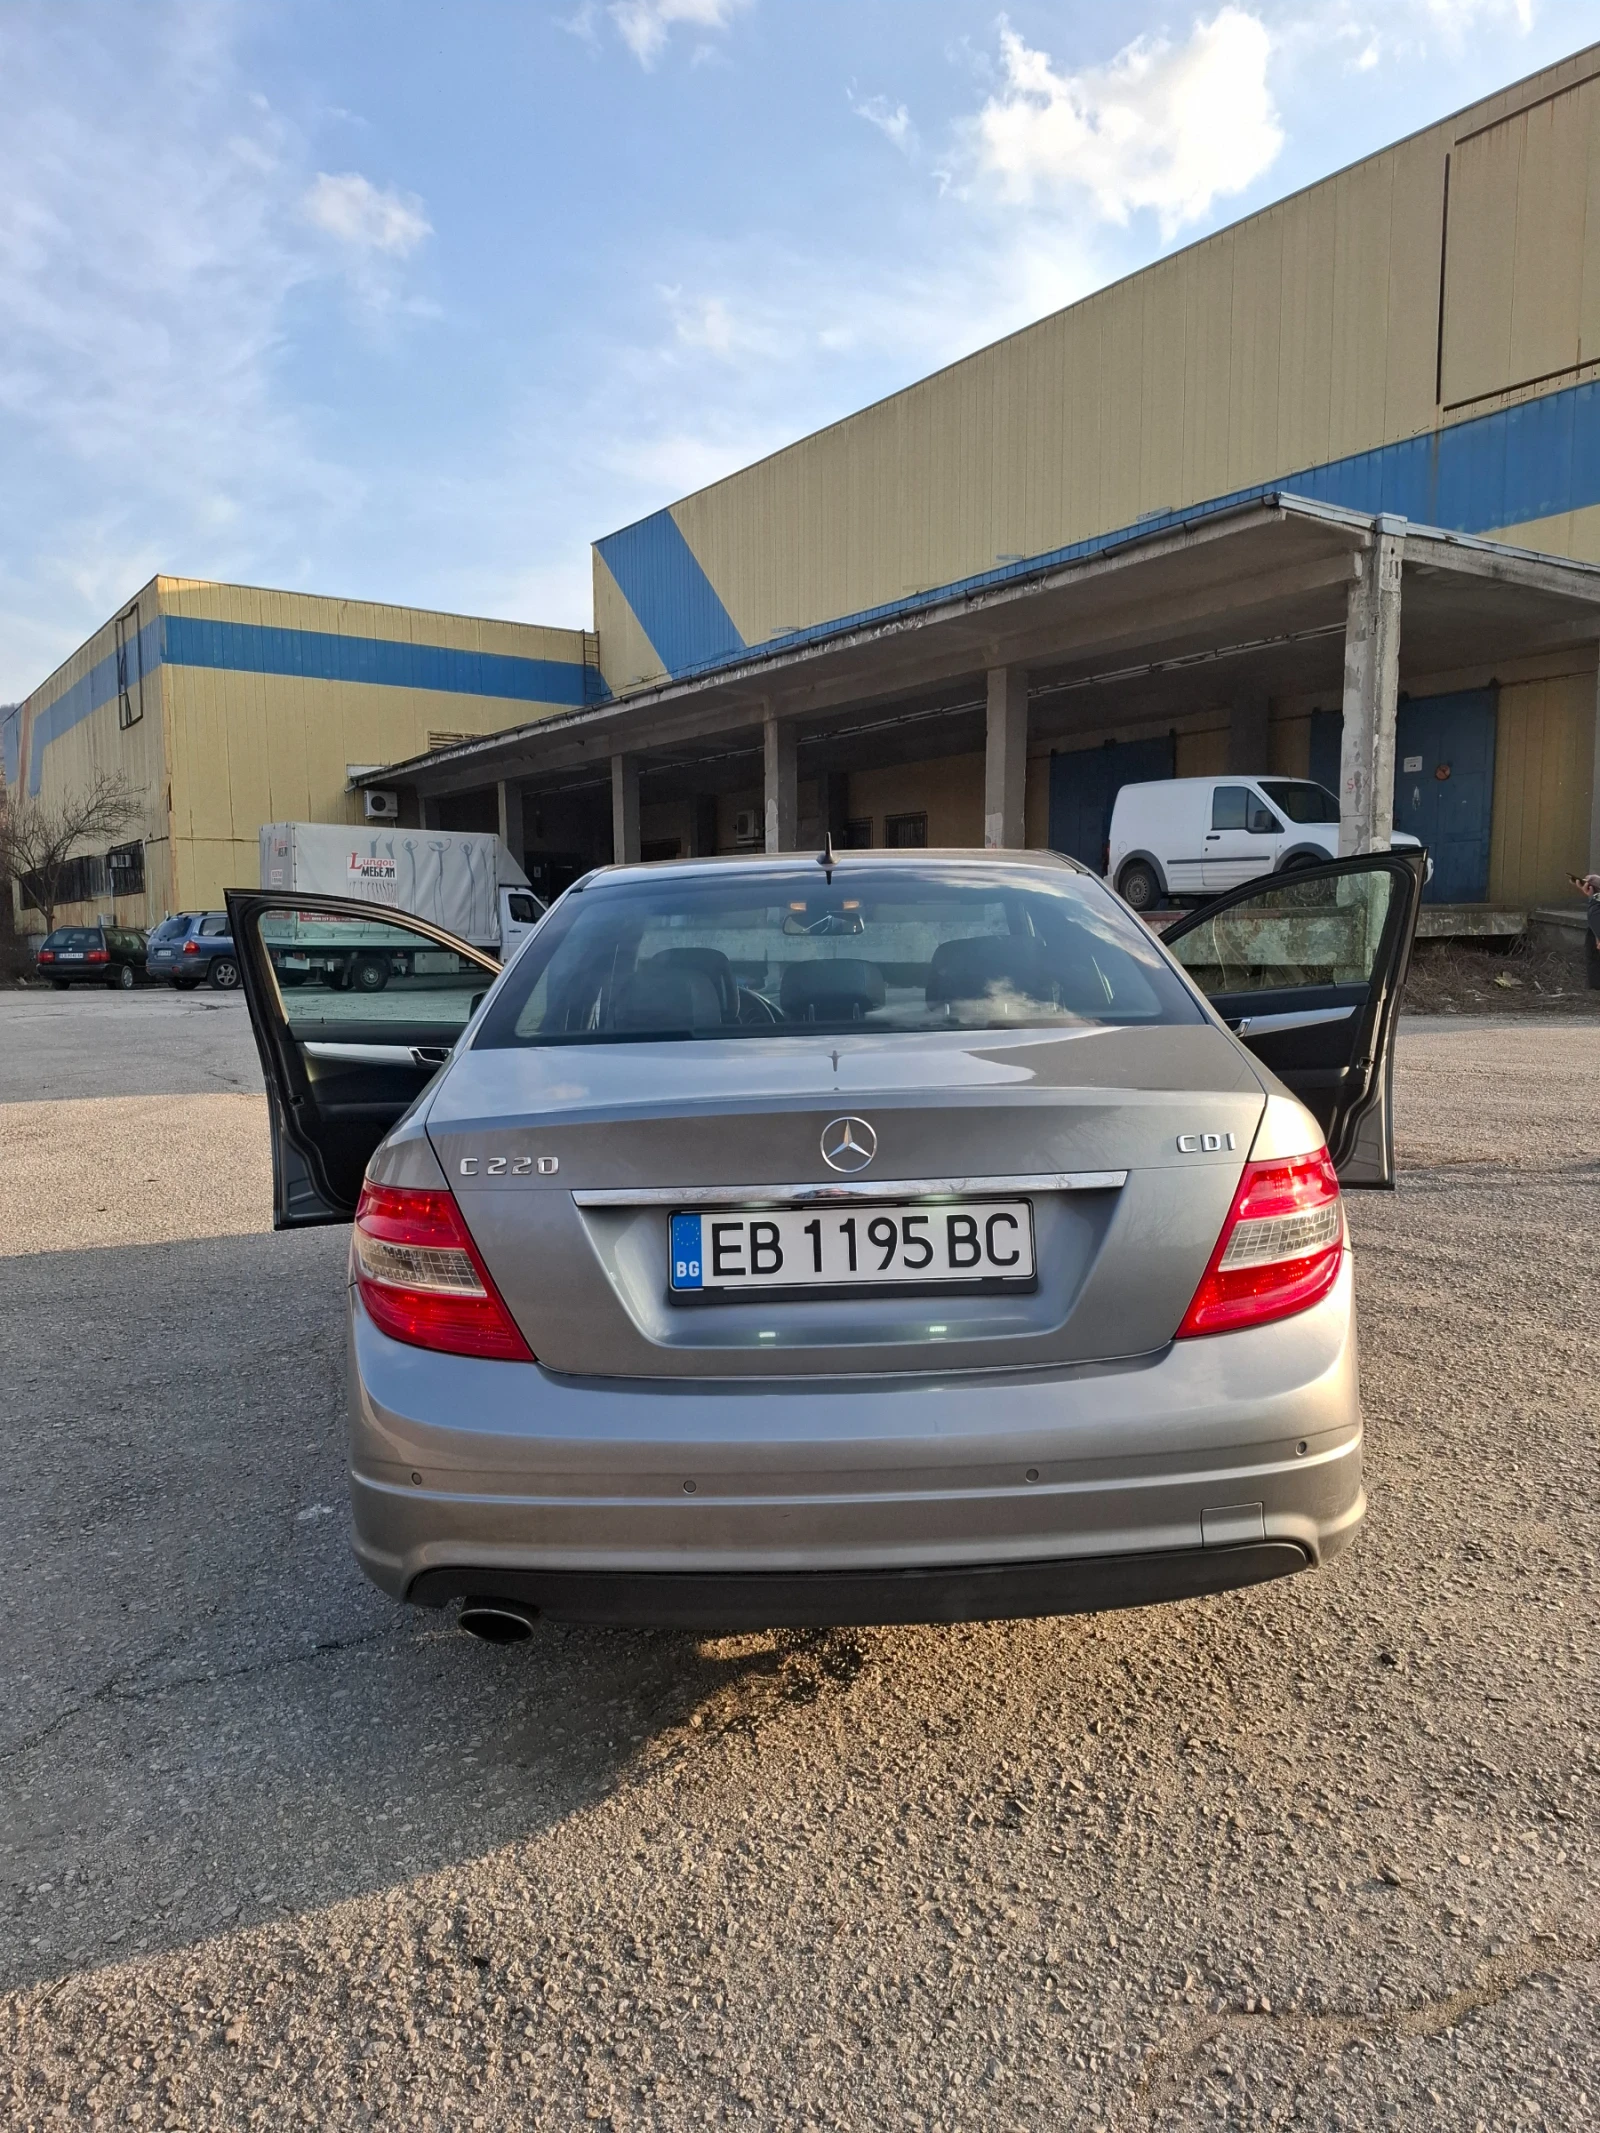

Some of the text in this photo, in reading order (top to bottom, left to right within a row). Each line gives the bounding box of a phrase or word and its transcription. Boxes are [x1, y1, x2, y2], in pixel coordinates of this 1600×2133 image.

[350, 852, 395, 869] Lungov
[361, 866, 395, 878] МЕБЕЛИ
[1176, 1133, 1236, 1153] CDI
[460, 1156, 559, 1176] C 220
[711, 1212, 1020, 1277] EB 1195 BC
[676, 1260, 700, 1278] BG
